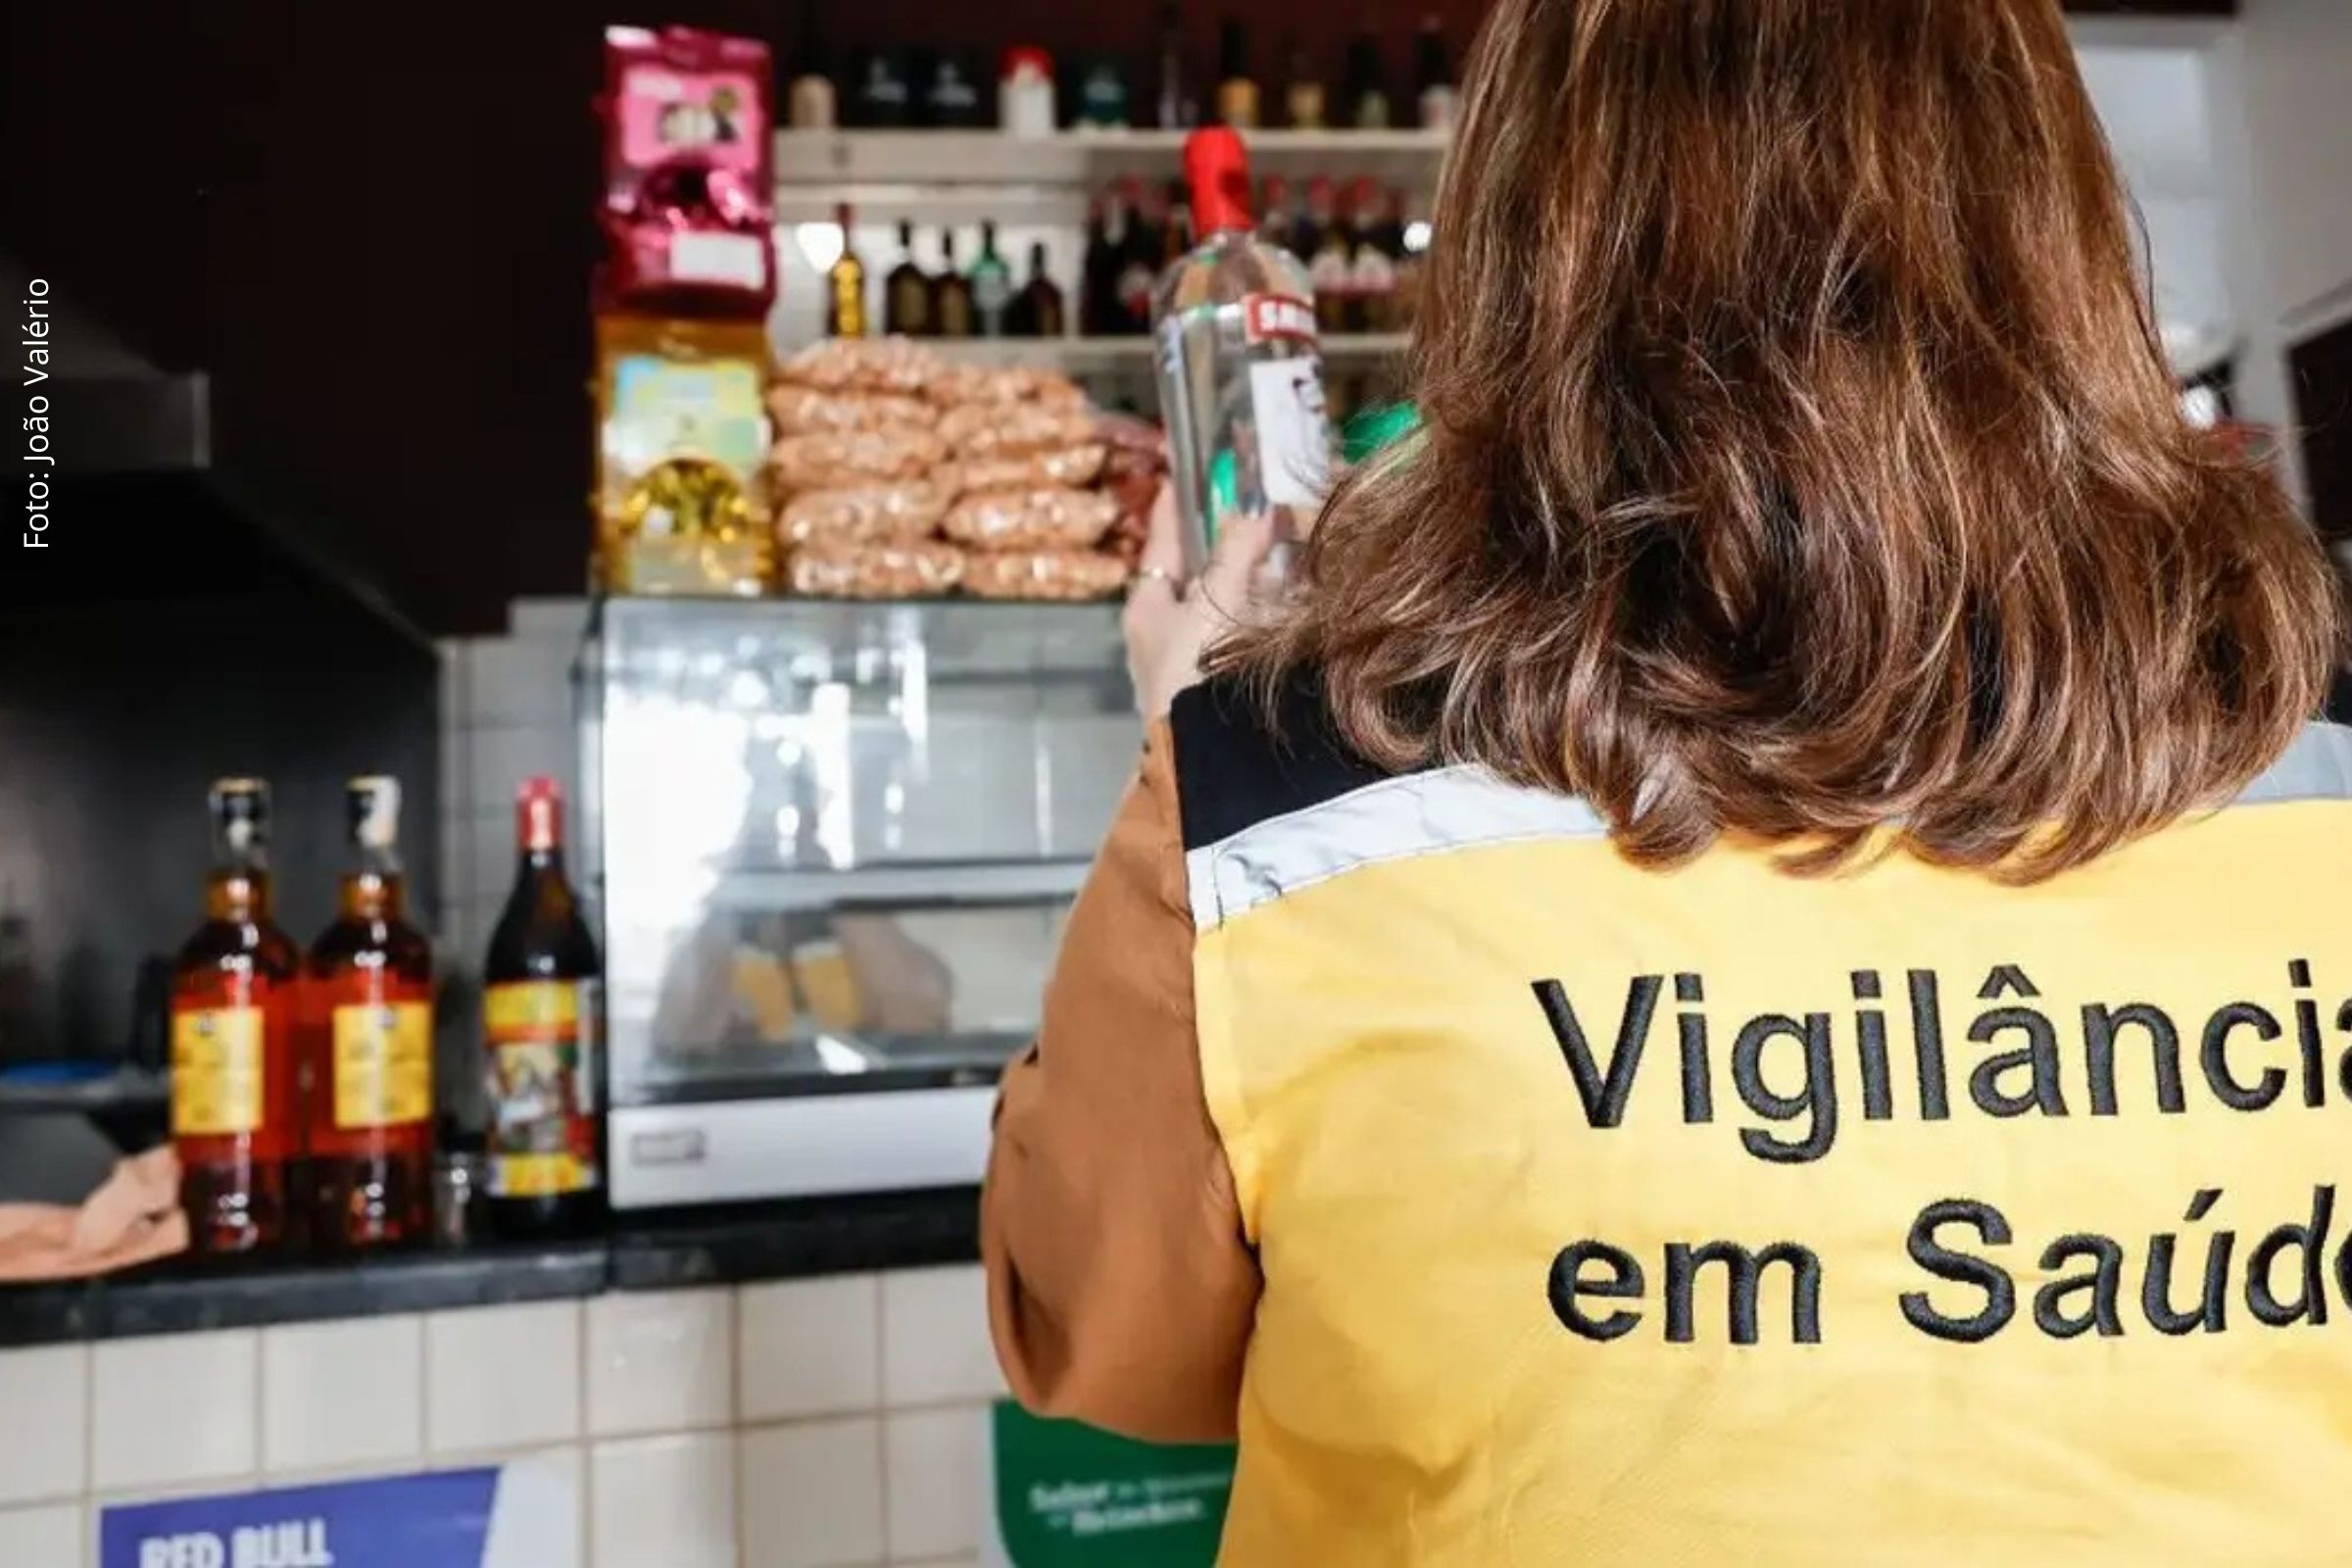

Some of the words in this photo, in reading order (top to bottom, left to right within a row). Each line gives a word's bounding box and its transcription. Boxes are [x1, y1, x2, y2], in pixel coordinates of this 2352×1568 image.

[1531, 959, 2352, 1163] Vigilânci
[1547, 1239, 1822, 1346] em
[1898, 1184, 2352, 1345] Saúd
